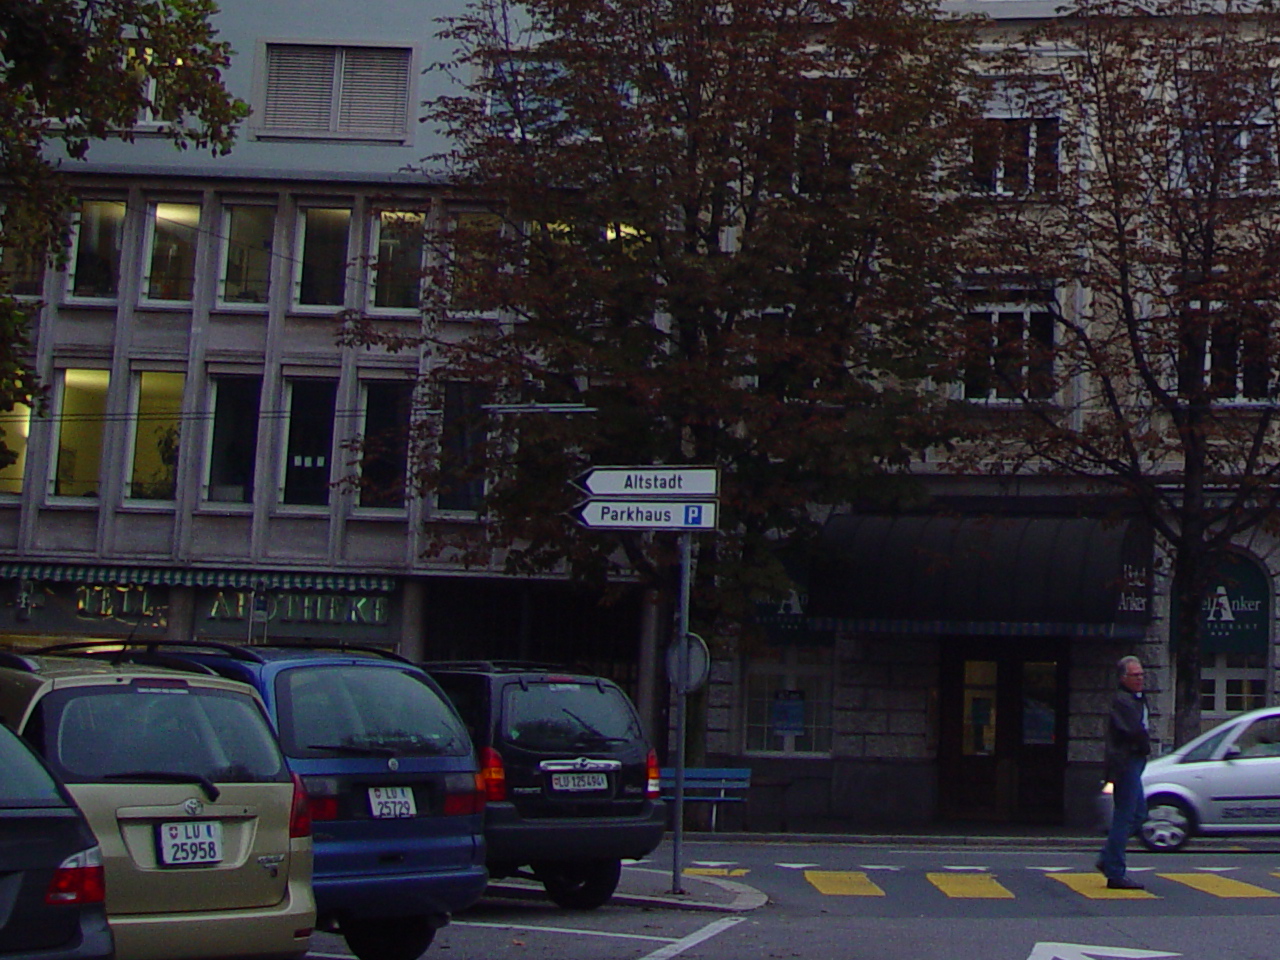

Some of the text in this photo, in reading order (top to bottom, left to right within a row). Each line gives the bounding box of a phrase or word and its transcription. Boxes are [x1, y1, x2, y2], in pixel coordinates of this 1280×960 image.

[624, 474, 683, 489] Altstadt
[601, 506, 699, 524] Parkhaus P
[1118, 591, 1147, 611] Anker
[558, 775, 569, 788] LU
[385, 788, 398, 799] LU
[377, 801, 411, 818] 25729
[185, 824, 200, 839] LU
[171, 841, 217, 861] 25958
